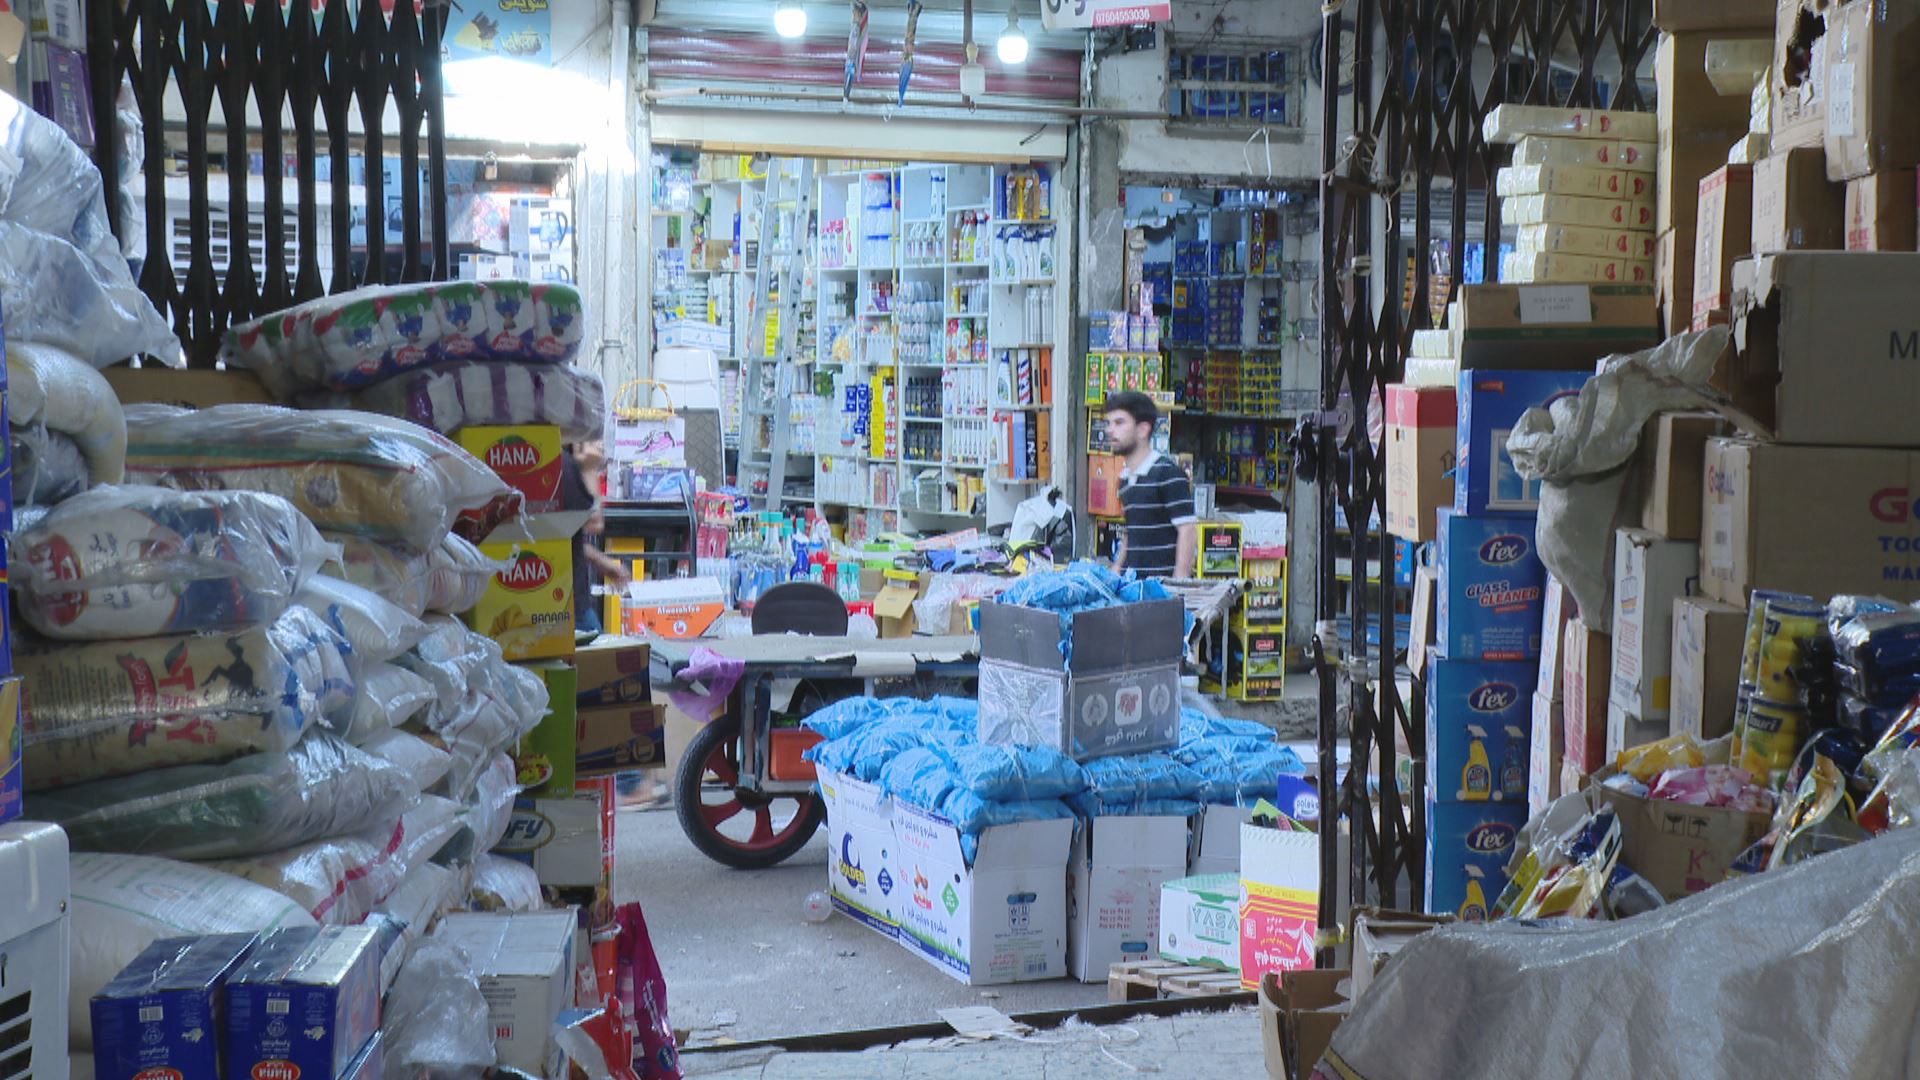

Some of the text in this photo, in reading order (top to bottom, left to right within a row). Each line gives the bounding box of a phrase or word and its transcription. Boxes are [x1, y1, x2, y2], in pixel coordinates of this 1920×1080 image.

[490, 447, 537, 466] HANA
[1488, 541, 1518, 561] fex
[501, 562, 548, 582] HANA
[1466, 581, 1509, 599] GLASS
[1480, 587, 1539, 607] CLEANER
[531, 610, 570, 625] BANANA
[1478, 687, 1508, 709] fex
[1475, 828, 1505, 849] fex
[839, 858, 866, 886] GOLDEN
